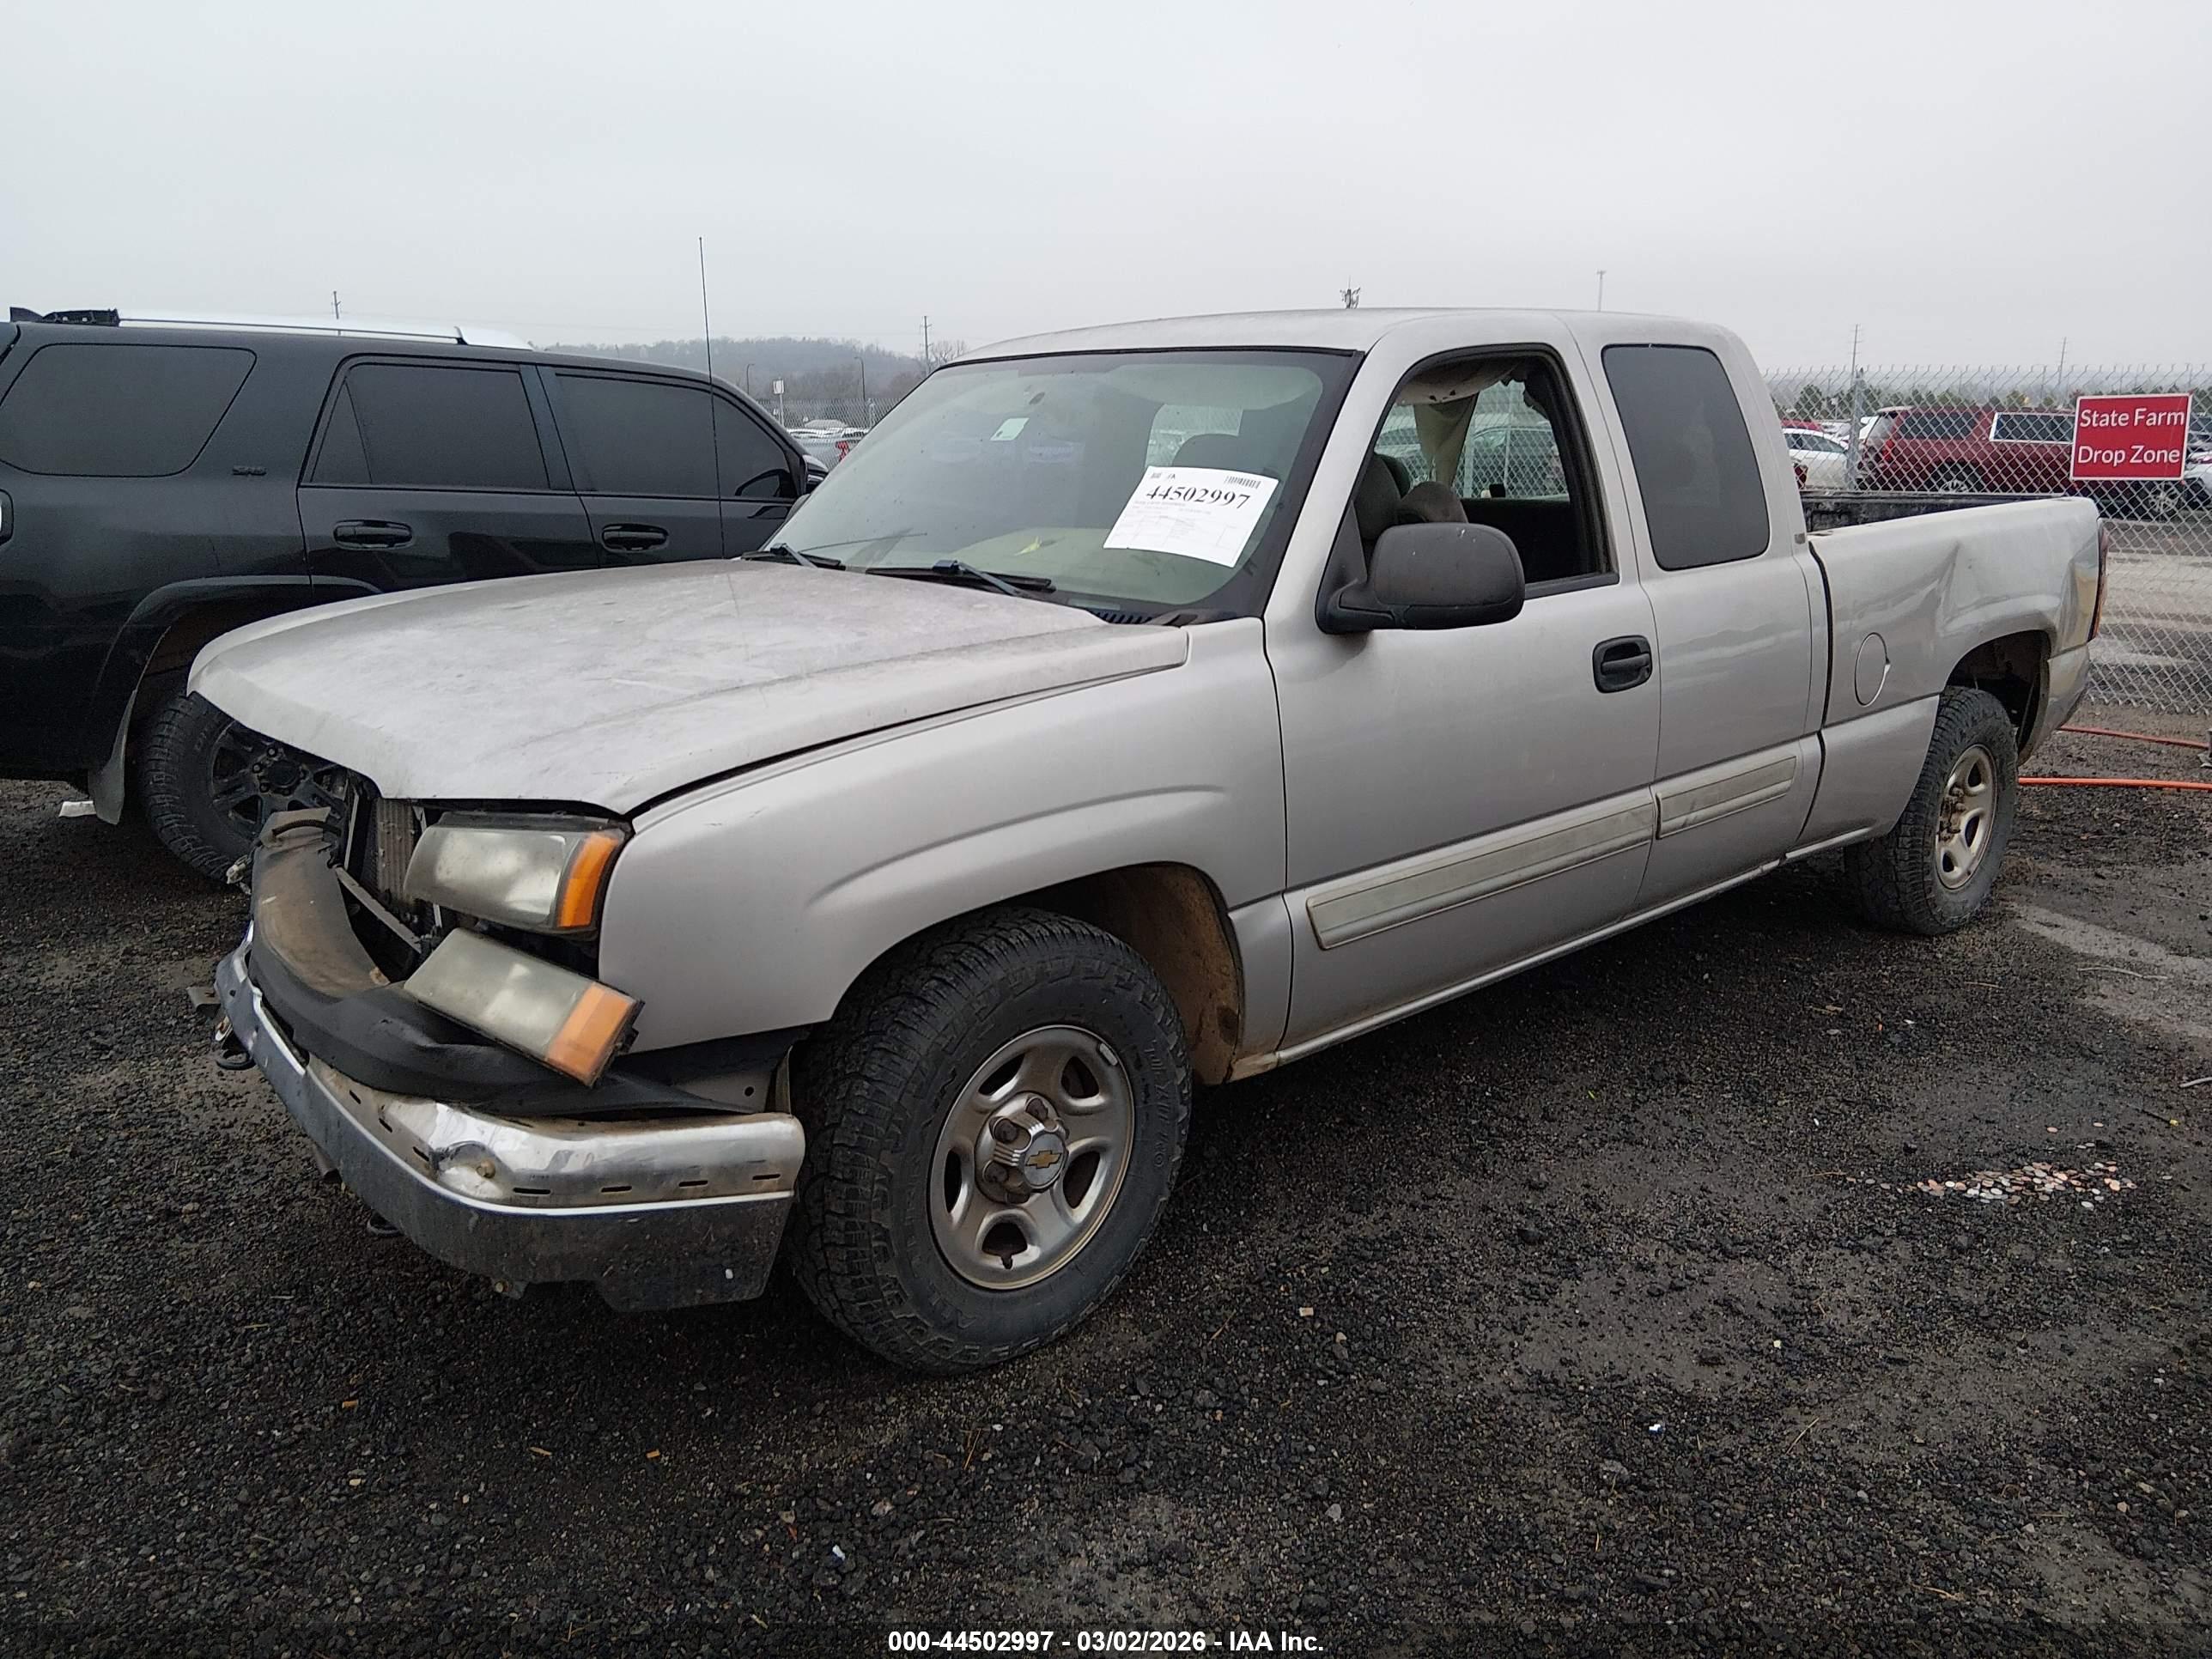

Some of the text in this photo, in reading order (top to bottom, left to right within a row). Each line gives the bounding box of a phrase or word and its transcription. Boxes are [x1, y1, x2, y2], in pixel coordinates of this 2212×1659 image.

[2080, 408, 2185, 428] State Farm
[2078, 445, 2179, 466] Drop Zone
[1146, 485, 1251, 508] 44502997
